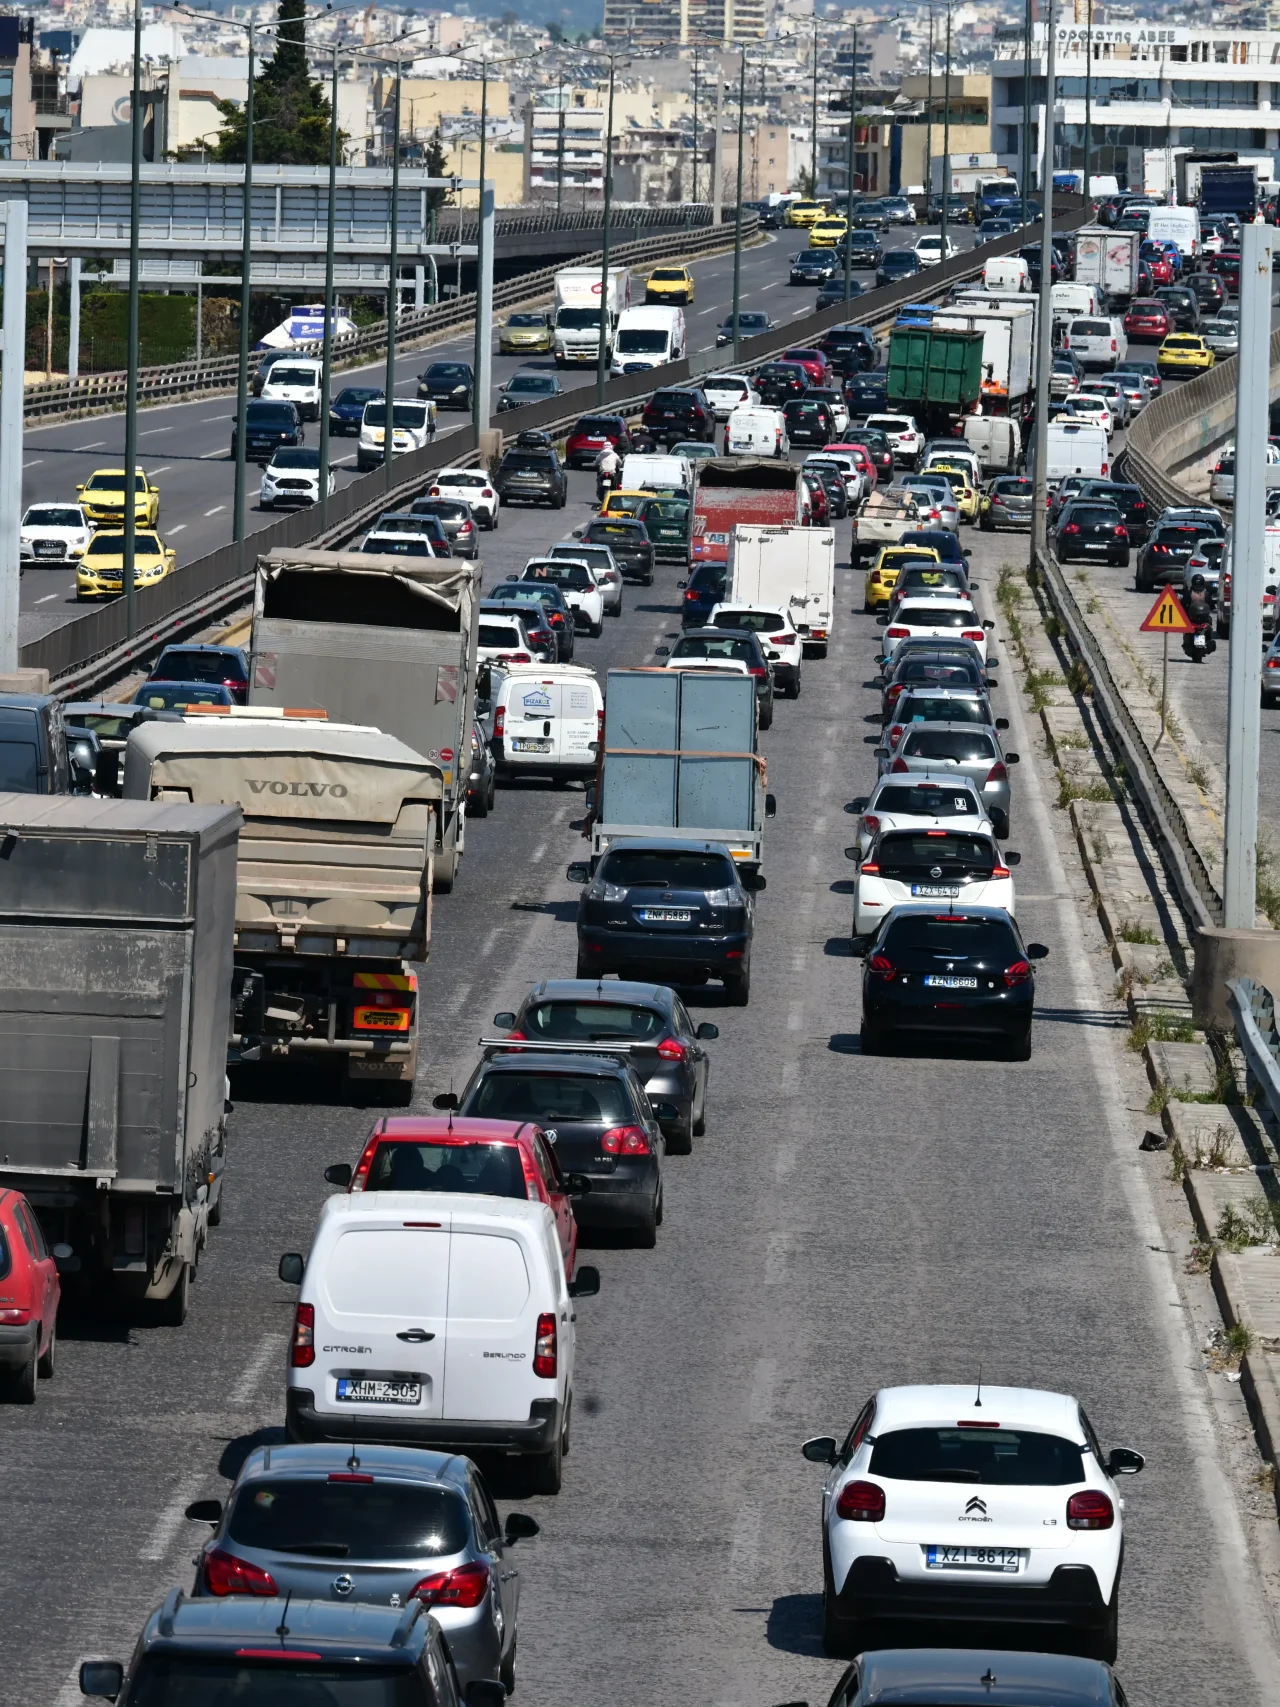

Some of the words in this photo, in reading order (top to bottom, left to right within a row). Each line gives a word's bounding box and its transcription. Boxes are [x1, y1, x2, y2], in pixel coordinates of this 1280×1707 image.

[245, 779, 348, 799] VOLVO
[350, 1380, 417, 1397] XHM-2505
[940, 1547, 1017, 1565] XZI-8612
